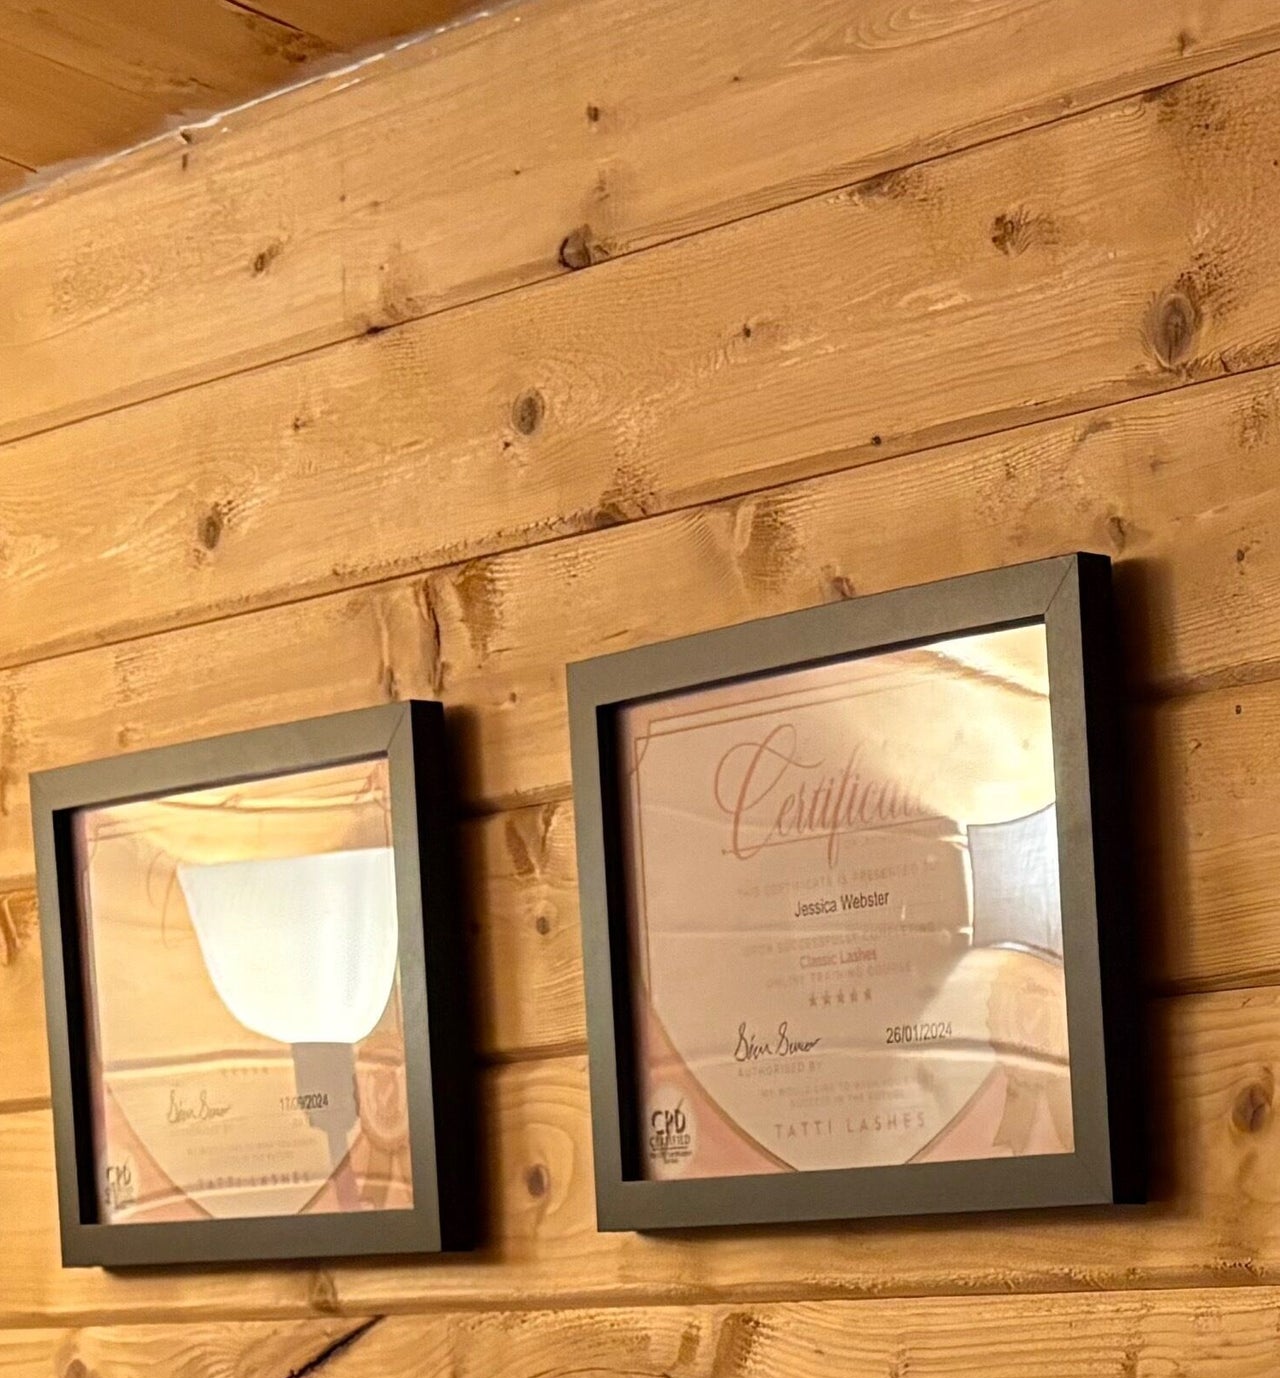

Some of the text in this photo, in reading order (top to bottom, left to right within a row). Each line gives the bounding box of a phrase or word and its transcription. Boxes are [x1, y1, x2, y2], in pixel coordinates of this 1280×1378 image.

[795, 892, 889, 917] Jessica Webster
[886, 1022, 952, 1044] 26/01/2024
[775, 1111, 925, 1139] TATTI LASHES
